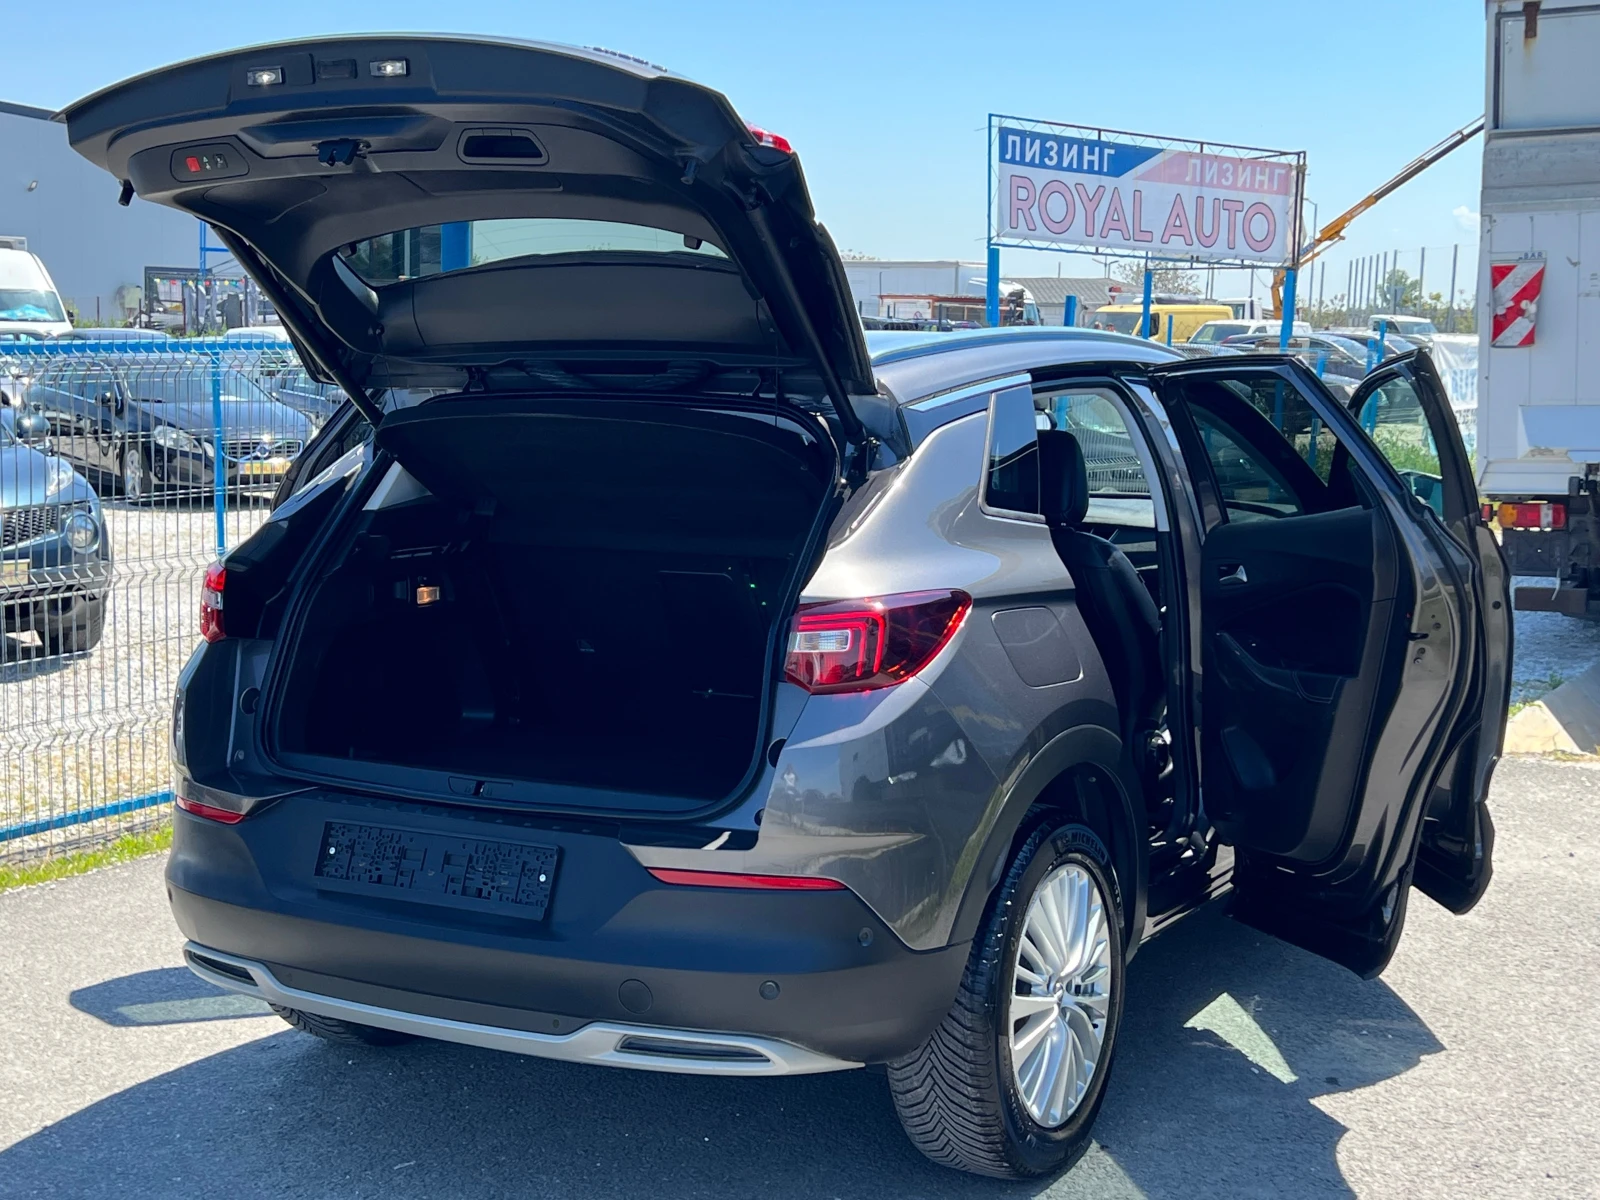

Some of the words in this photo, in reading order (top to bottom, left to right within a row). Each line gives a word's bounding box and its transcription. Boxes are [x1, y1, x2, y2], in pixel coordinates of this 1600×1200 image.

[1005, 134, 1115, 172] ЛИЗИНГ
[1185, 158, 1286, 191] ЛИЗИНГ
[1009, 174, 1153, 242] ROYAL
[1160, 193, 1276, 252] AUTO
[1071, 831, 1106, 862] MICHELIN
